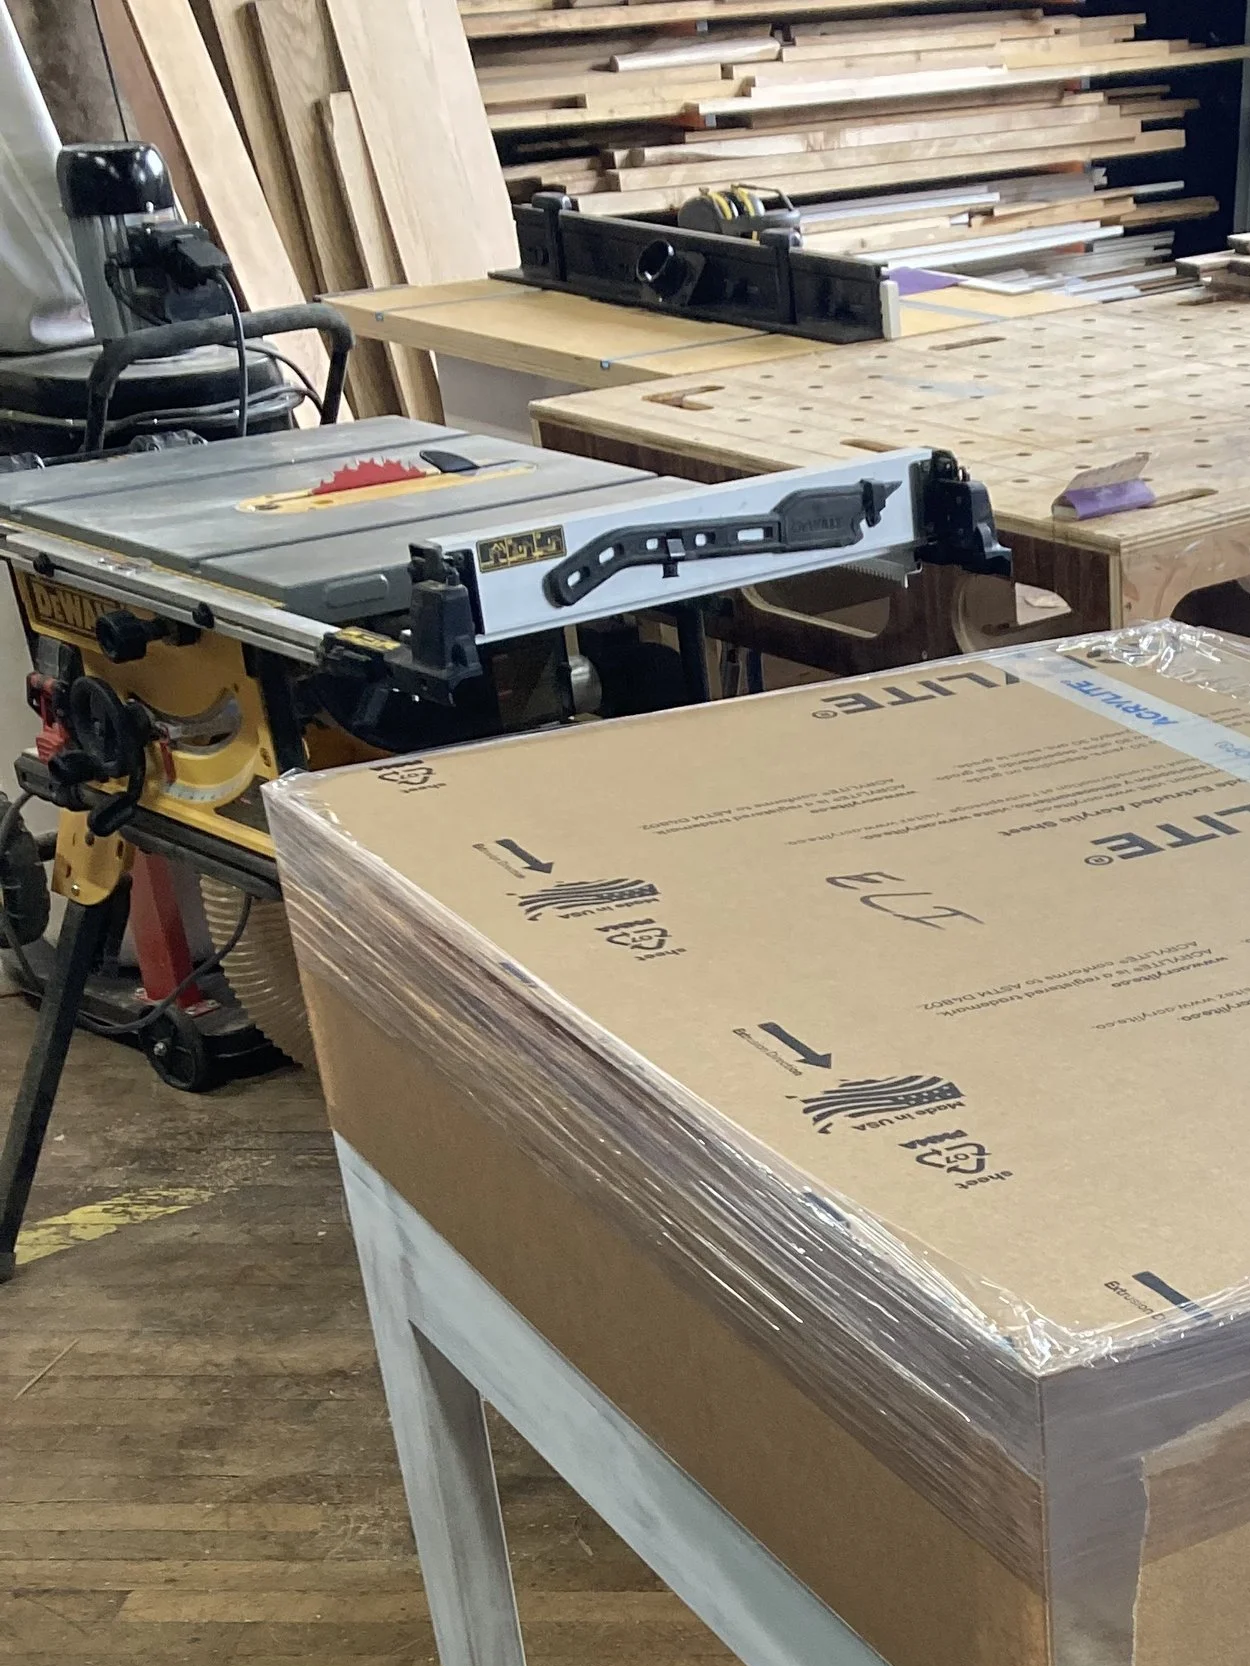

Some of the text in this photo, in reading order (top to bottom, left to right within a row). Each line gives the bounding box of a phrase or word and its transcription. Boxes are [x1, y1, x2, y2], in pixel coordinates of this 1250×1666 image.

[32, 582, 117, 630] DEWA
[1128, 785, 1214, 808] Extruded
[1058, 804, 1125, 823] Acrylic
[997, 820, 1057, 836] Sheet
[613, 897, 659, 908] Made
[556, 909, 595, 919] USA
[633, 947, 686, 961] sheet
[850, 1100, 965, 1131] Made in USA
[897, 1128, 968, 1149] PMMA
[944, 1152, 969, 1164] 07
[953, 1170, 1013, 1189] sheet
